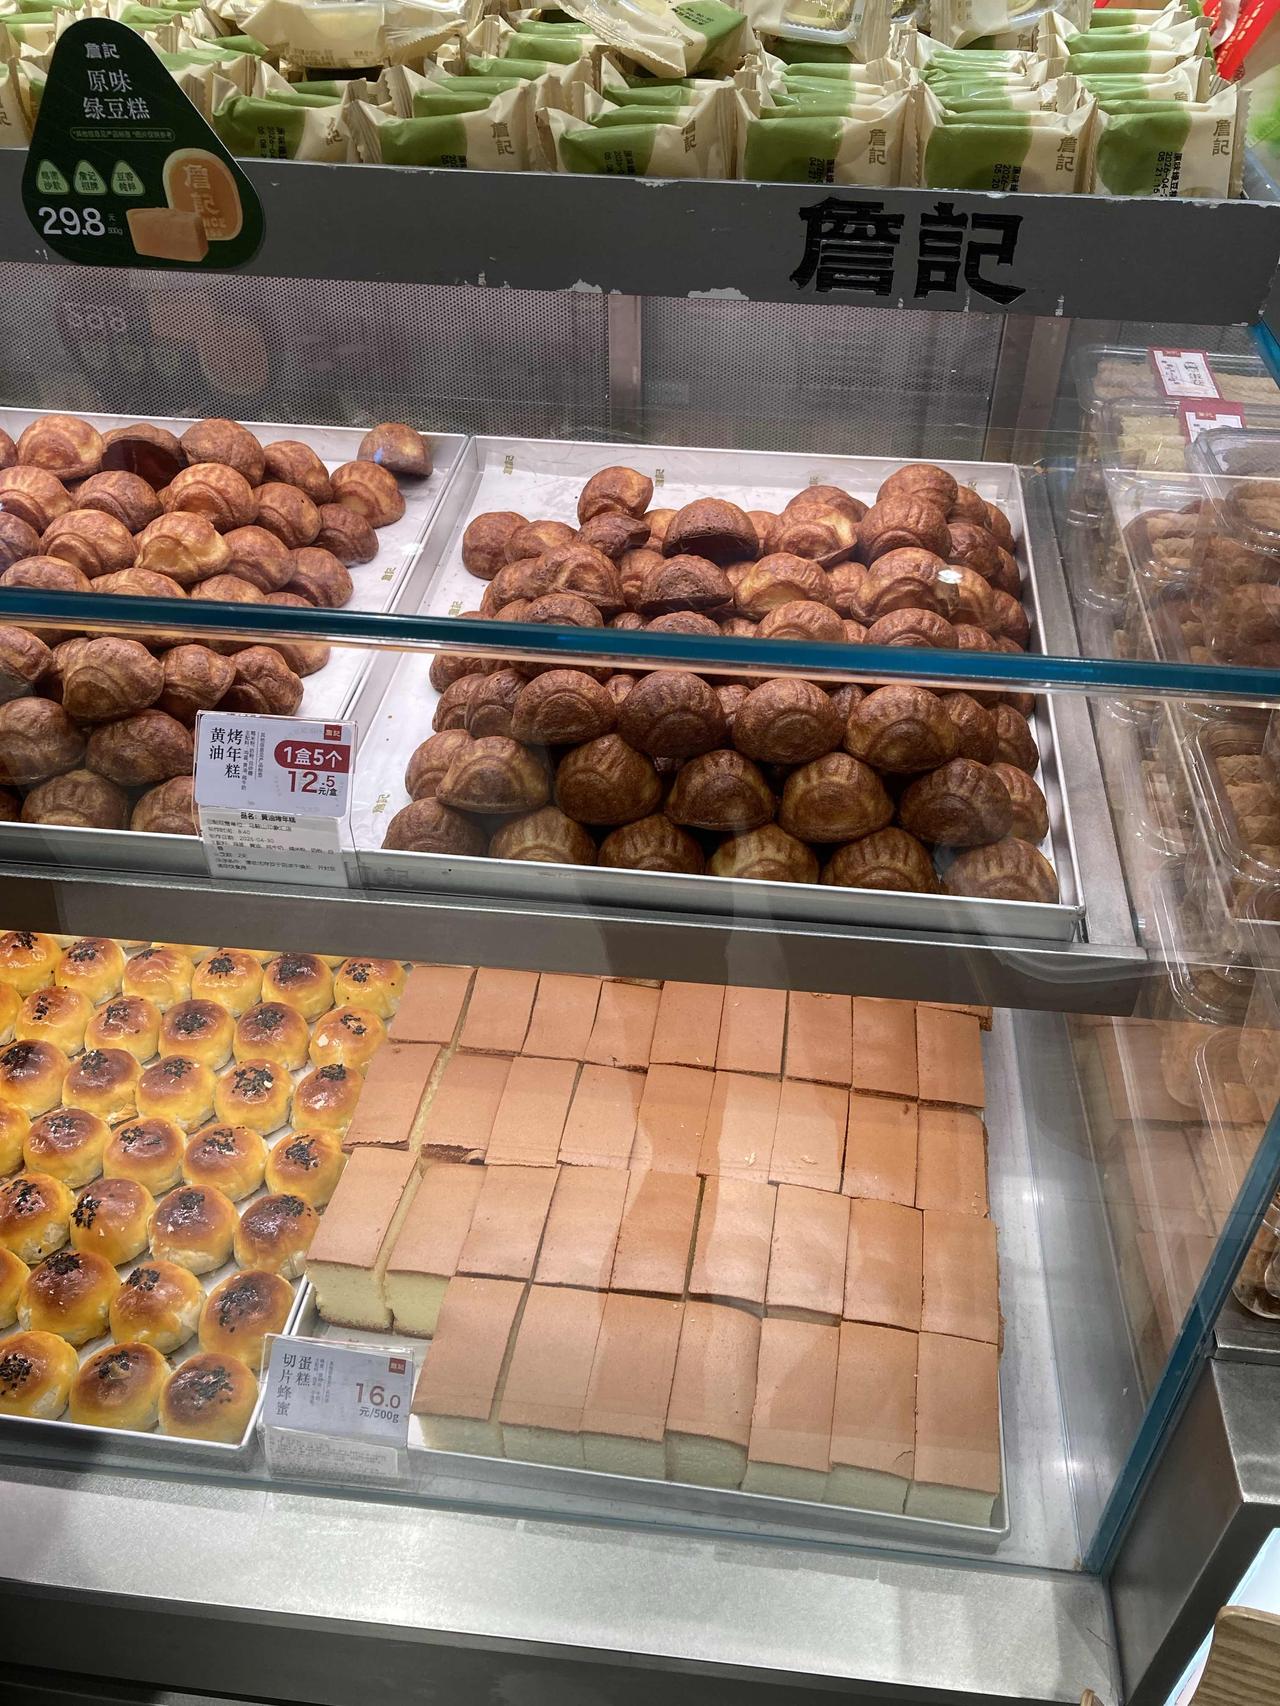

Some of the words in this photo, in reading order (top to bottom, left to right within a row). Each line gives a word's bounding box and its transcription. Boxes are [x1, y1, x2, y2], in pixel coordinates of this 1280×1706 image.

[84, 42, 120, 59] 詹記
[87, 69, 133, 92] 原味
[83, 97, 151, 119] 绿豆糕
[491, 121, 515, 155] 詹記
[868, 128, 887, 165] 詹記
[1213, 119, 1232, 156] 詹記
[1056, 136, 1078, 172] 詹記
[38, 207, 106, 236] 29.8
[790, 197, 1026, 305] 詹記
[209, 727, 226, 760] 黄油
[224, 728, 243, 778] 烤年糕
[283, 746, 343, 768] 1盒5个
[287, 770, 335, 793] 12.5
[318, 787, 338, 797] 元/盒
[276, 1353, 297, 1416] 切片蜂蜜
[296, 1356, 312, 1387] 蛋糕
[356, 1382, 401, 1409] 16.0
[359, 1406, 400, 1424] 元/500g
